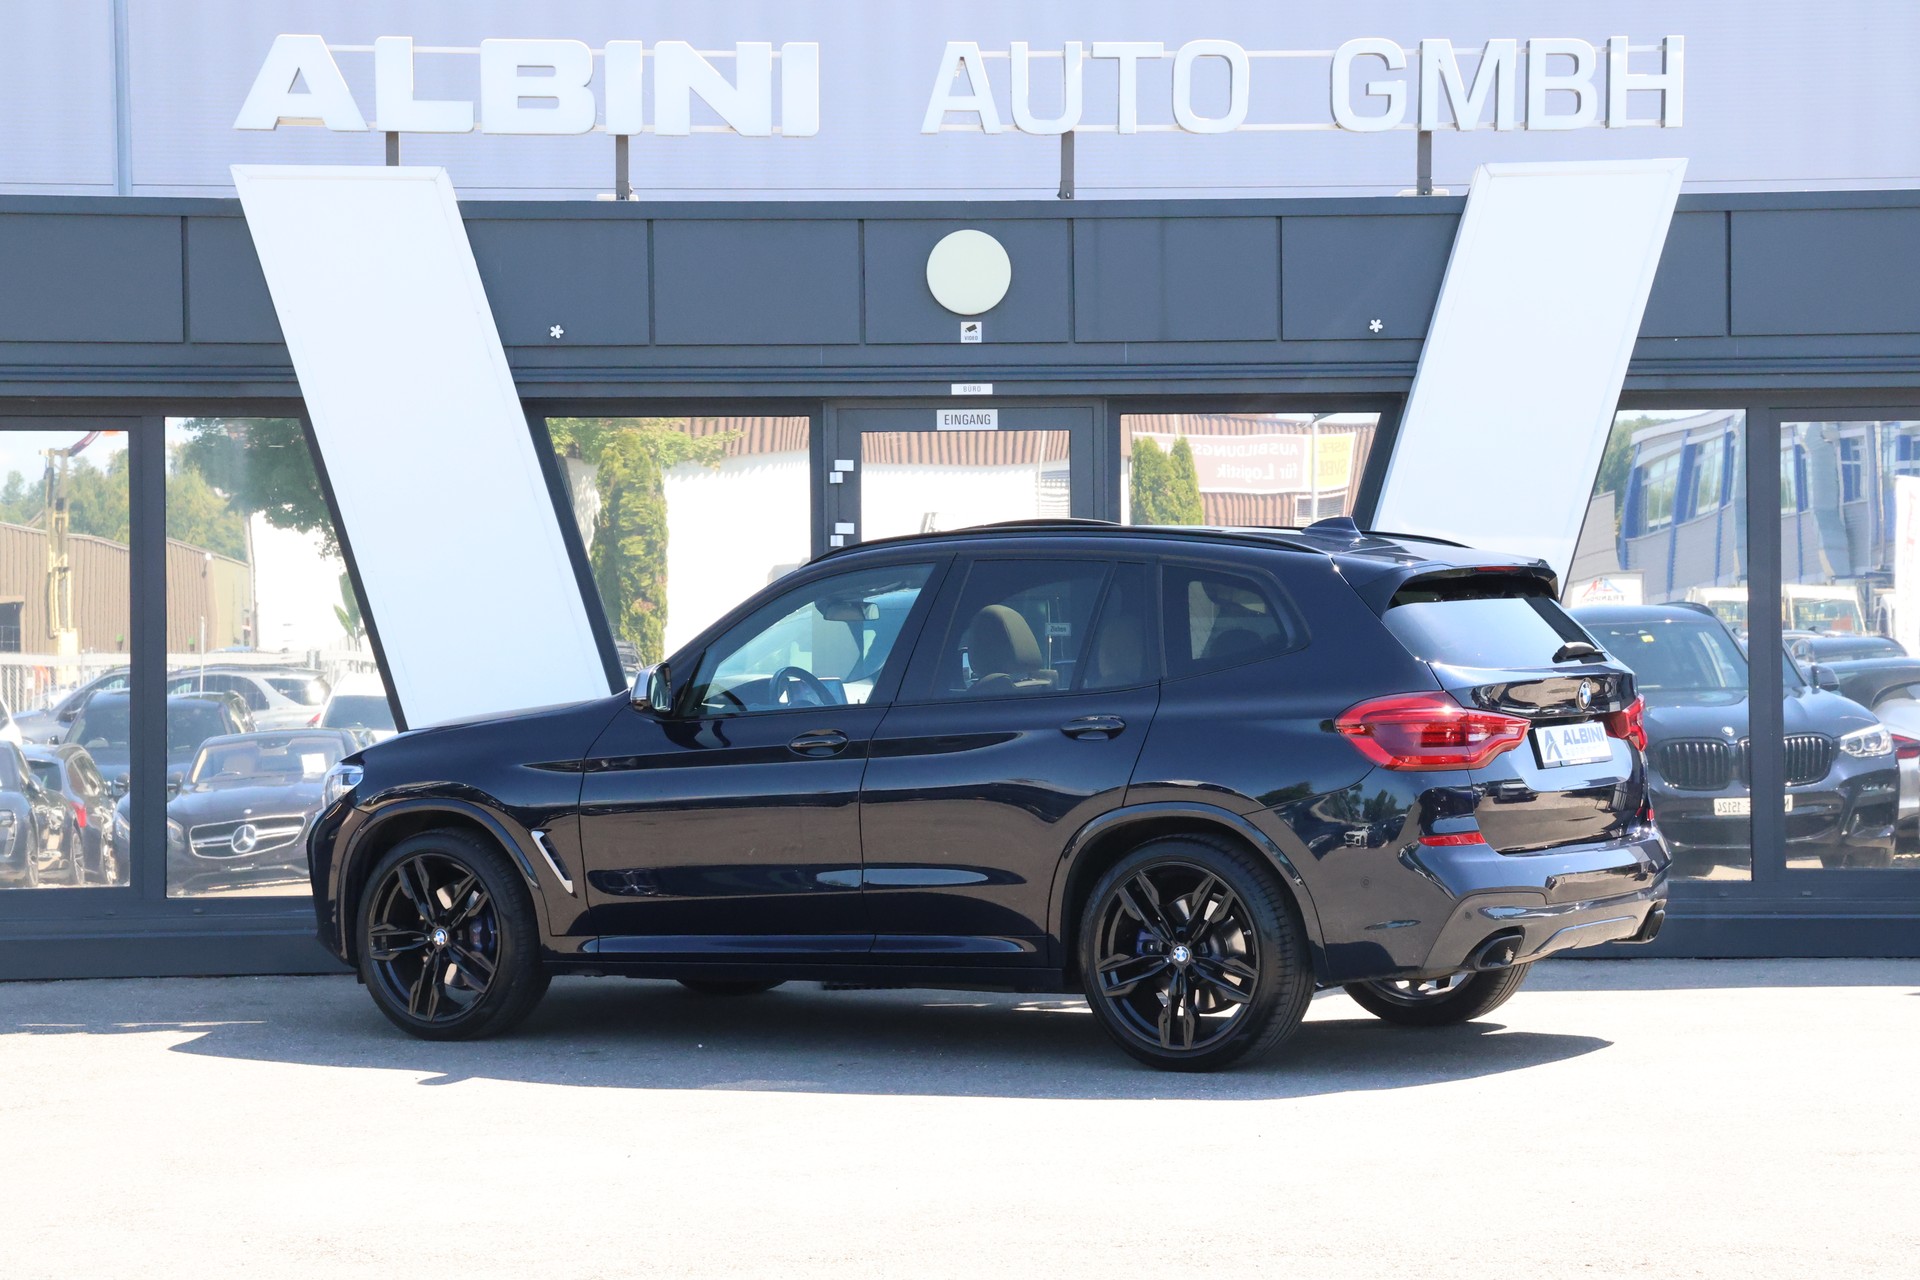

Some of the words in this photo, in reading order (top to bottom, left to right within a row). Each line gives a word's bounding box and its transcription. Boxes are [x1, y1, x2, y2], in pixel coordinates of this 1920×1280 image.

[233, 34, 819, 137] ALBINI
[921, 40, 1250, 136] AUTO
[1330, 35, 1685, 133] GMBH
[962, 385, 982, 393] BÜRO
[943, 413, 991, 426] EINGANG
[1563, 726, 1605, 746] ALBINI
